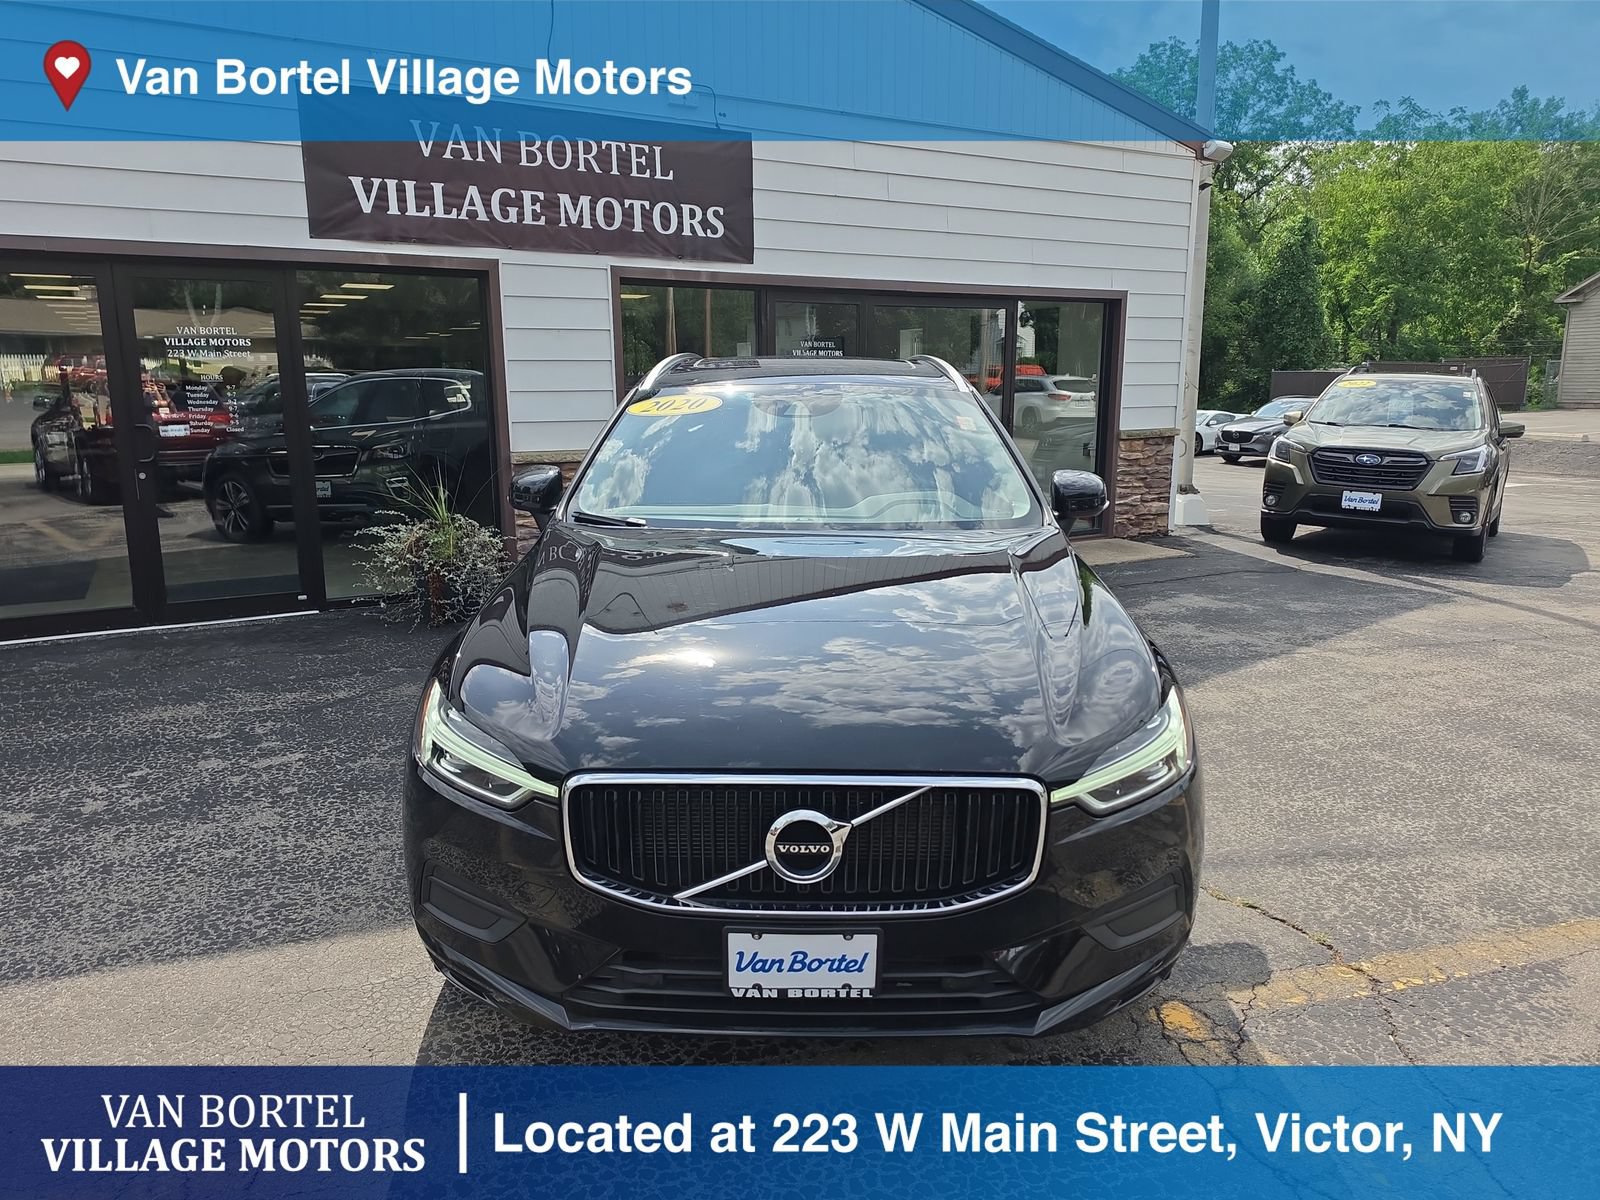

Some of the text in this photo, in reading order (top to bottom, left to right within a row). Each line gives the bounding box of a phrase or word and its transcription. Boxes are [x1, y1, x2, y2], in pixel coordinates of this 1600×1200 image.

[408, 119, 675, 181] VAN BORTEL
[347, 175, 726, 239] VILLAGE MOTORS
[176, 327, 238, 335] VAN BORTEL
[164, 338, 251, 347] VILLAGE MOTORS
[167, 349, 251, 359] 223 W Main Street
[818, 349, 843, 357] MOTORS
[640, 399, 708, 412] 2020
[1344, 495, 1379, 504] Van Bortel
[777, 844, 830, 853] VOLVO
[735, 951, 869, 973] Van Bortel
[731, 988, 873, 998] VAN BORTEL
